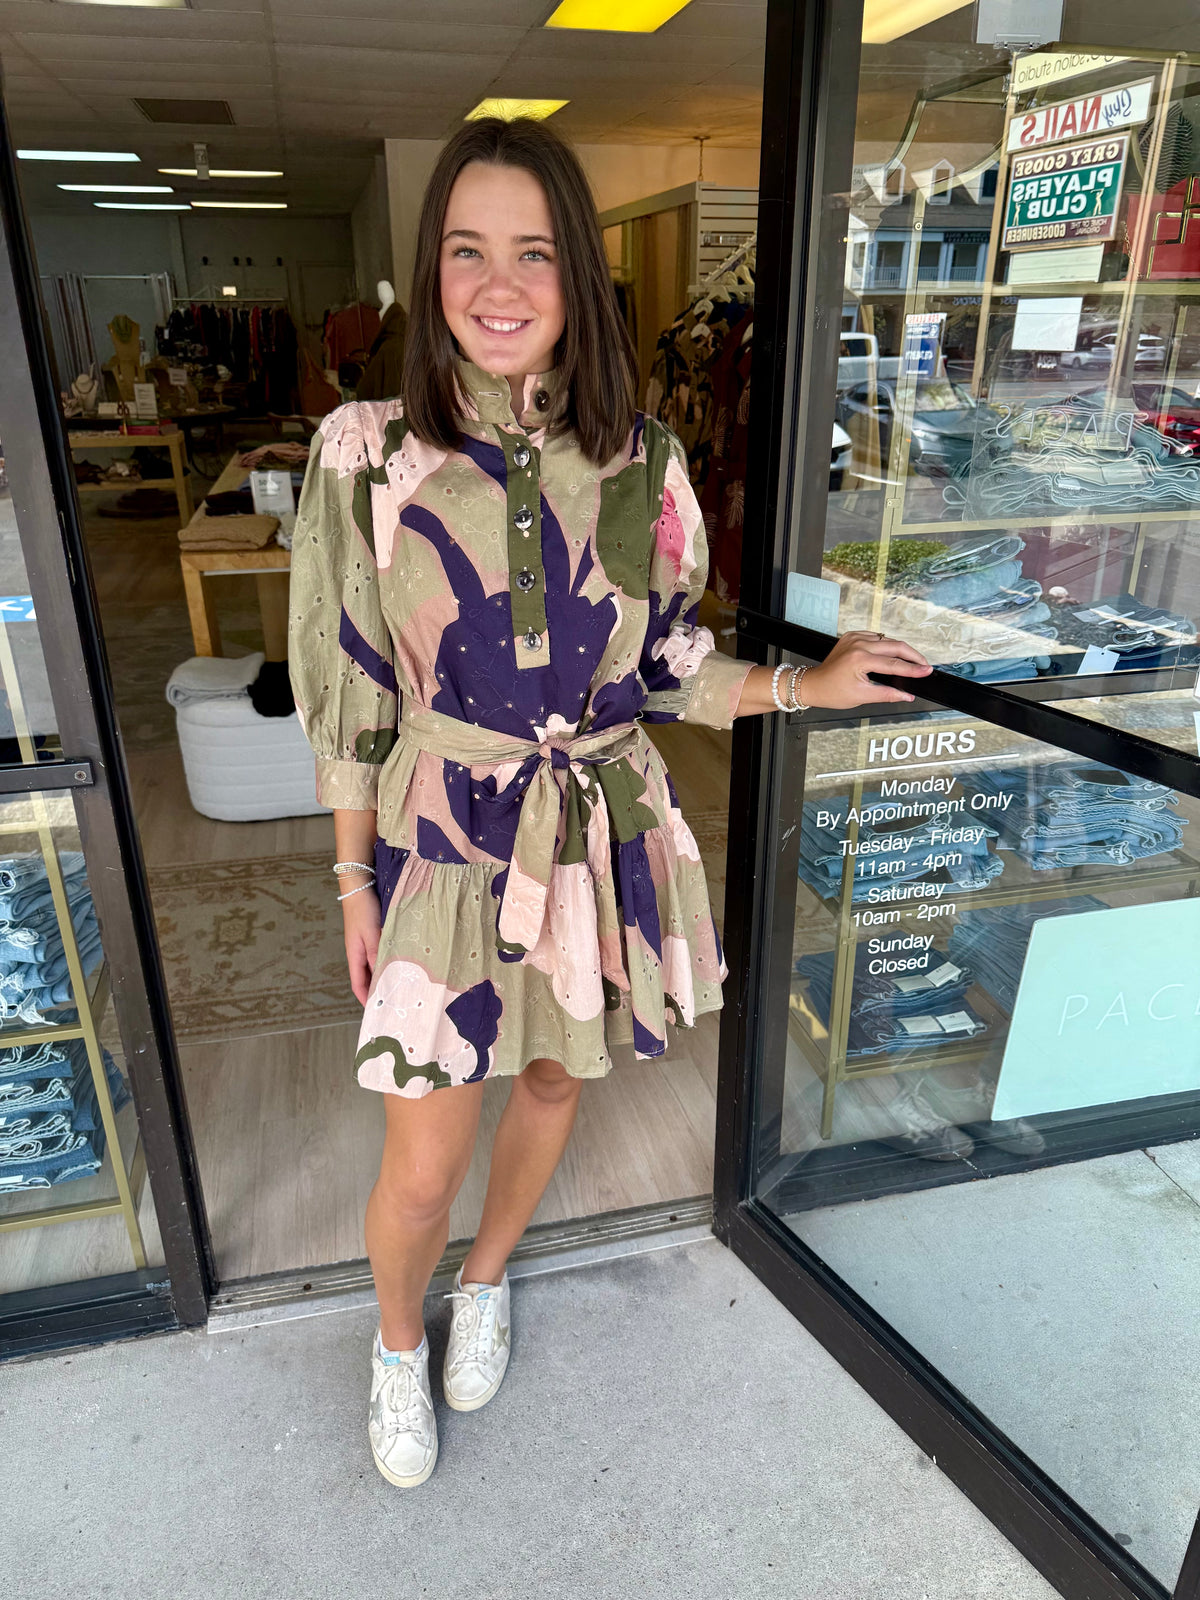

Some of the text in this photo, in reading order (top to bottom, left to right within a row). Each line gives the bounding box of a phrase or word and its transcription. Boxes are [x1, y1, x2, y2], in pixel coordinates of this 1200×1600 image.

[868, 729, 976, 762] HOURS
[880, 776, 957, 797] Monday
[816, 791, 1013, 830] By Appointment Only
[838, 835, 914, 857] Tuesday
[930, 827, 985, 846] Friday
[857, 860, 906, 877] 11am
[923, 852, 962, 872] 4pm
[867, 882, 946, 904] Saturday
[853, 910, 901, 927] 10am
[917, 902, 956, 922] 2pm
[867, 934, 935, 954] Sunday
[868, 953, 929, 975] Closed
[1057, 983, 1200, 1036] PAC
